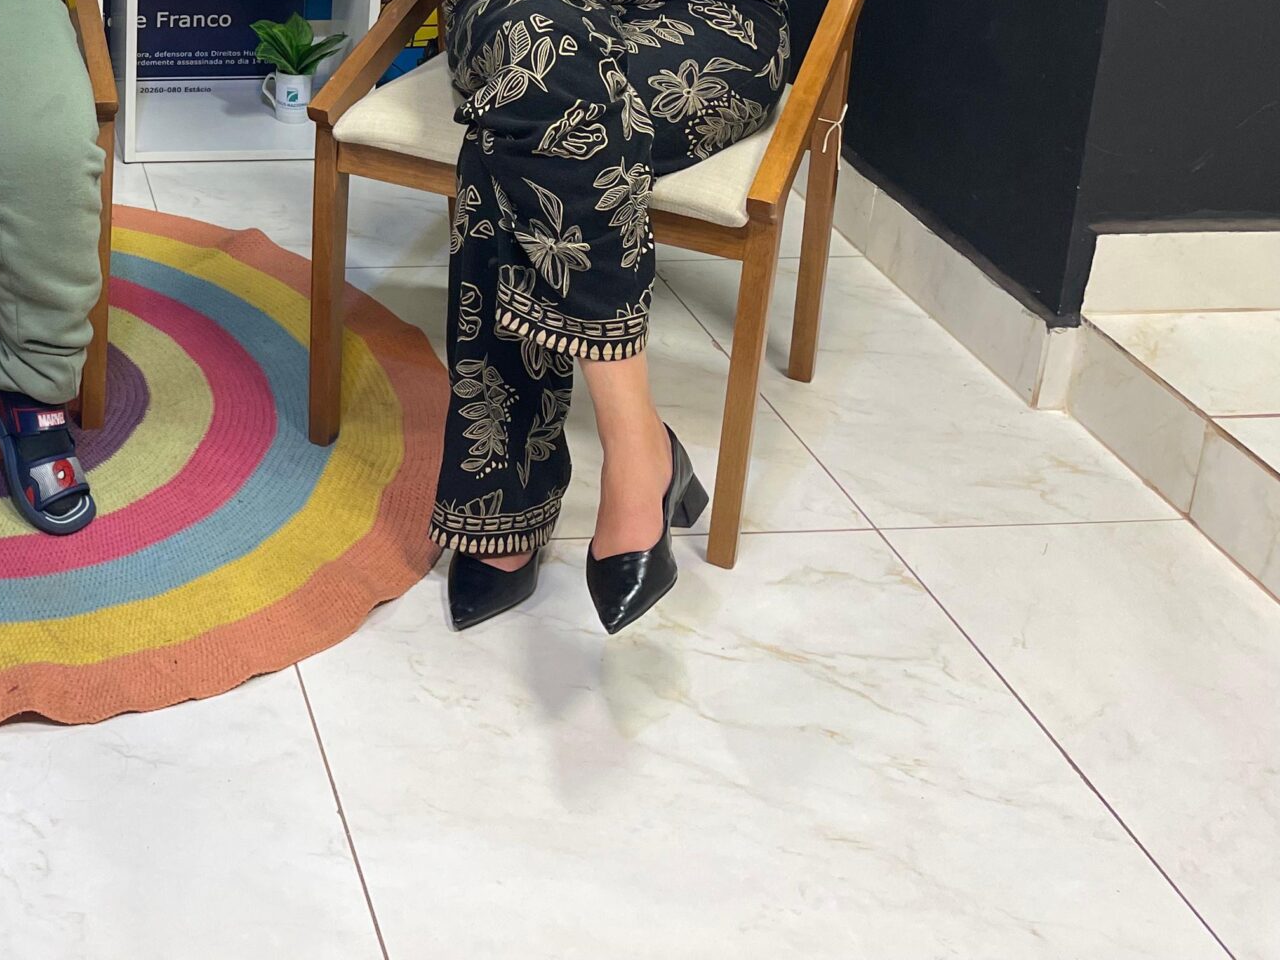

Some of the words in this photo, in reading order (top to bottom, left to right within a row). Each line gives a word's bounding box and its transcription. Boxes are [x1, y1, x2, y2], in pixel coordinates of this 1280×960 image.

[156, 11, 232, 28] Franco
[154, 50, 193, 58] defensora
[195, 50, 209, 58] dos
[210, 49, 241, 57] Direitos
[176, 58, 224, 66] assassinada
[139, 86, 182, 94] 20260-080
[184, 85, 212, 93] Estácio
[37, 410, 66, 427] MARVEL
